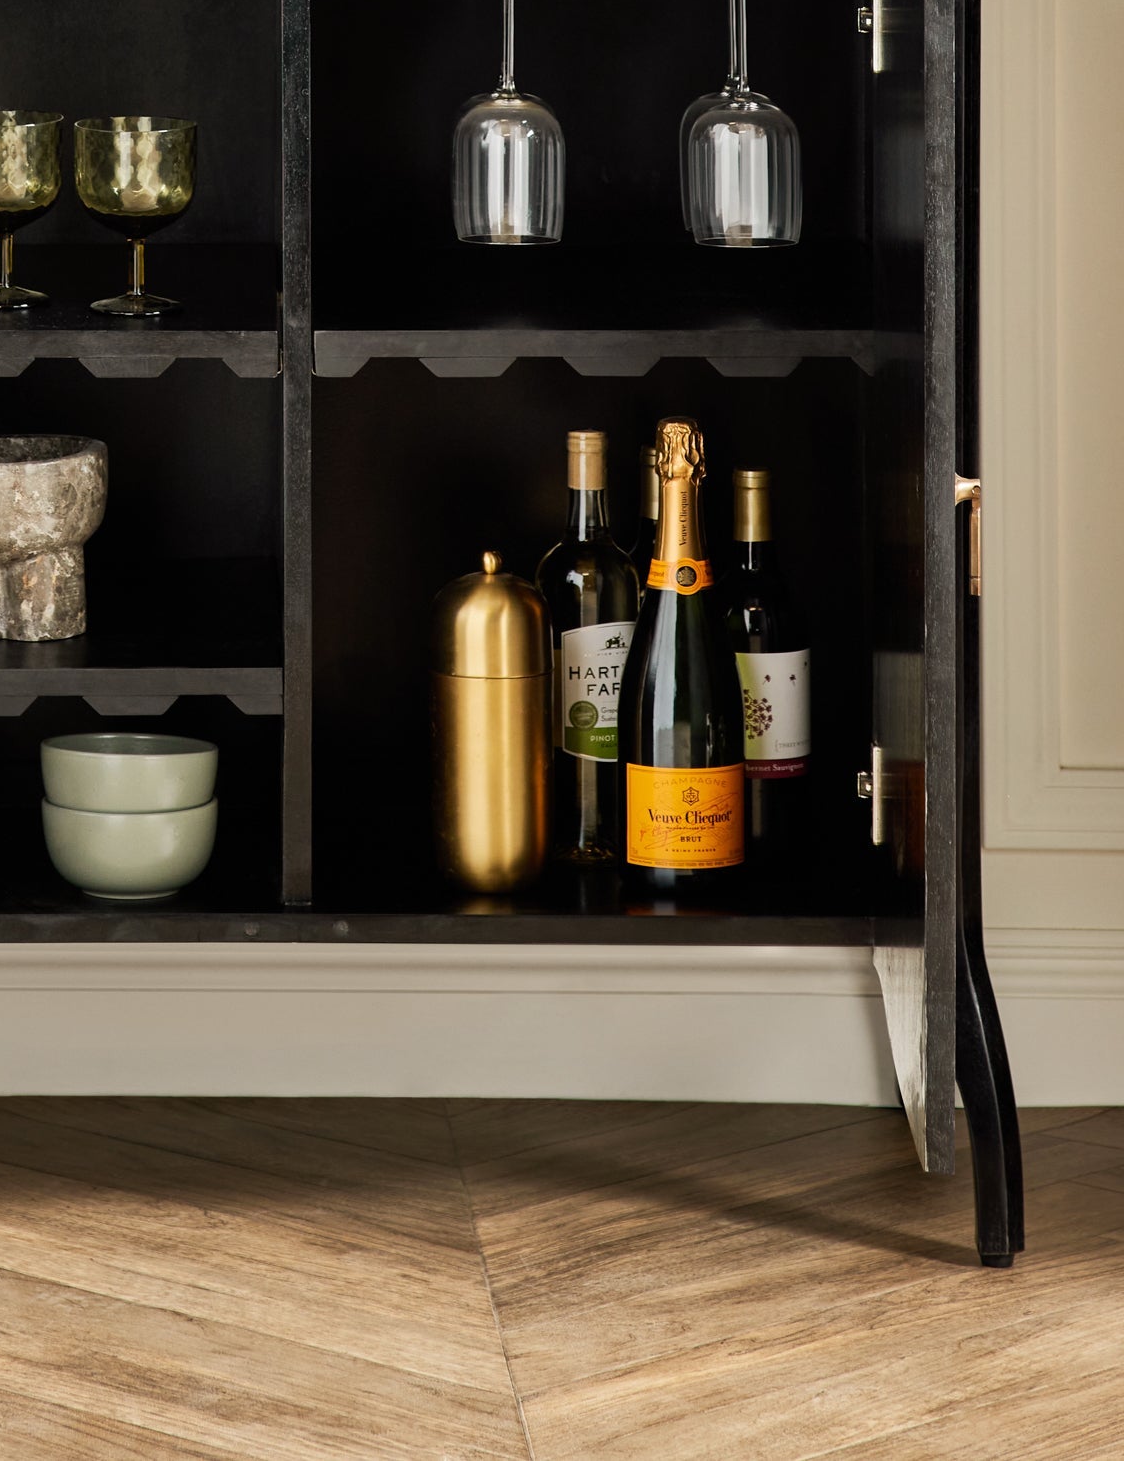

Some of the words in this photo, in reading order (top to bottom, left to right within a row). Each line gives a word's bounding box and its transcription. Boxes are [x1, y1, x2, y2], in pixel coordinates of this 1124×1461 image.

[679, 491, 689, 522] Clicquot
[679, 524, 687, 546] Veuve
[653, 777, 727, 789] CHAMPAGNE
[648, 808, 682, 824] Veuve
[685, 810, 732, 826] Clicquot
